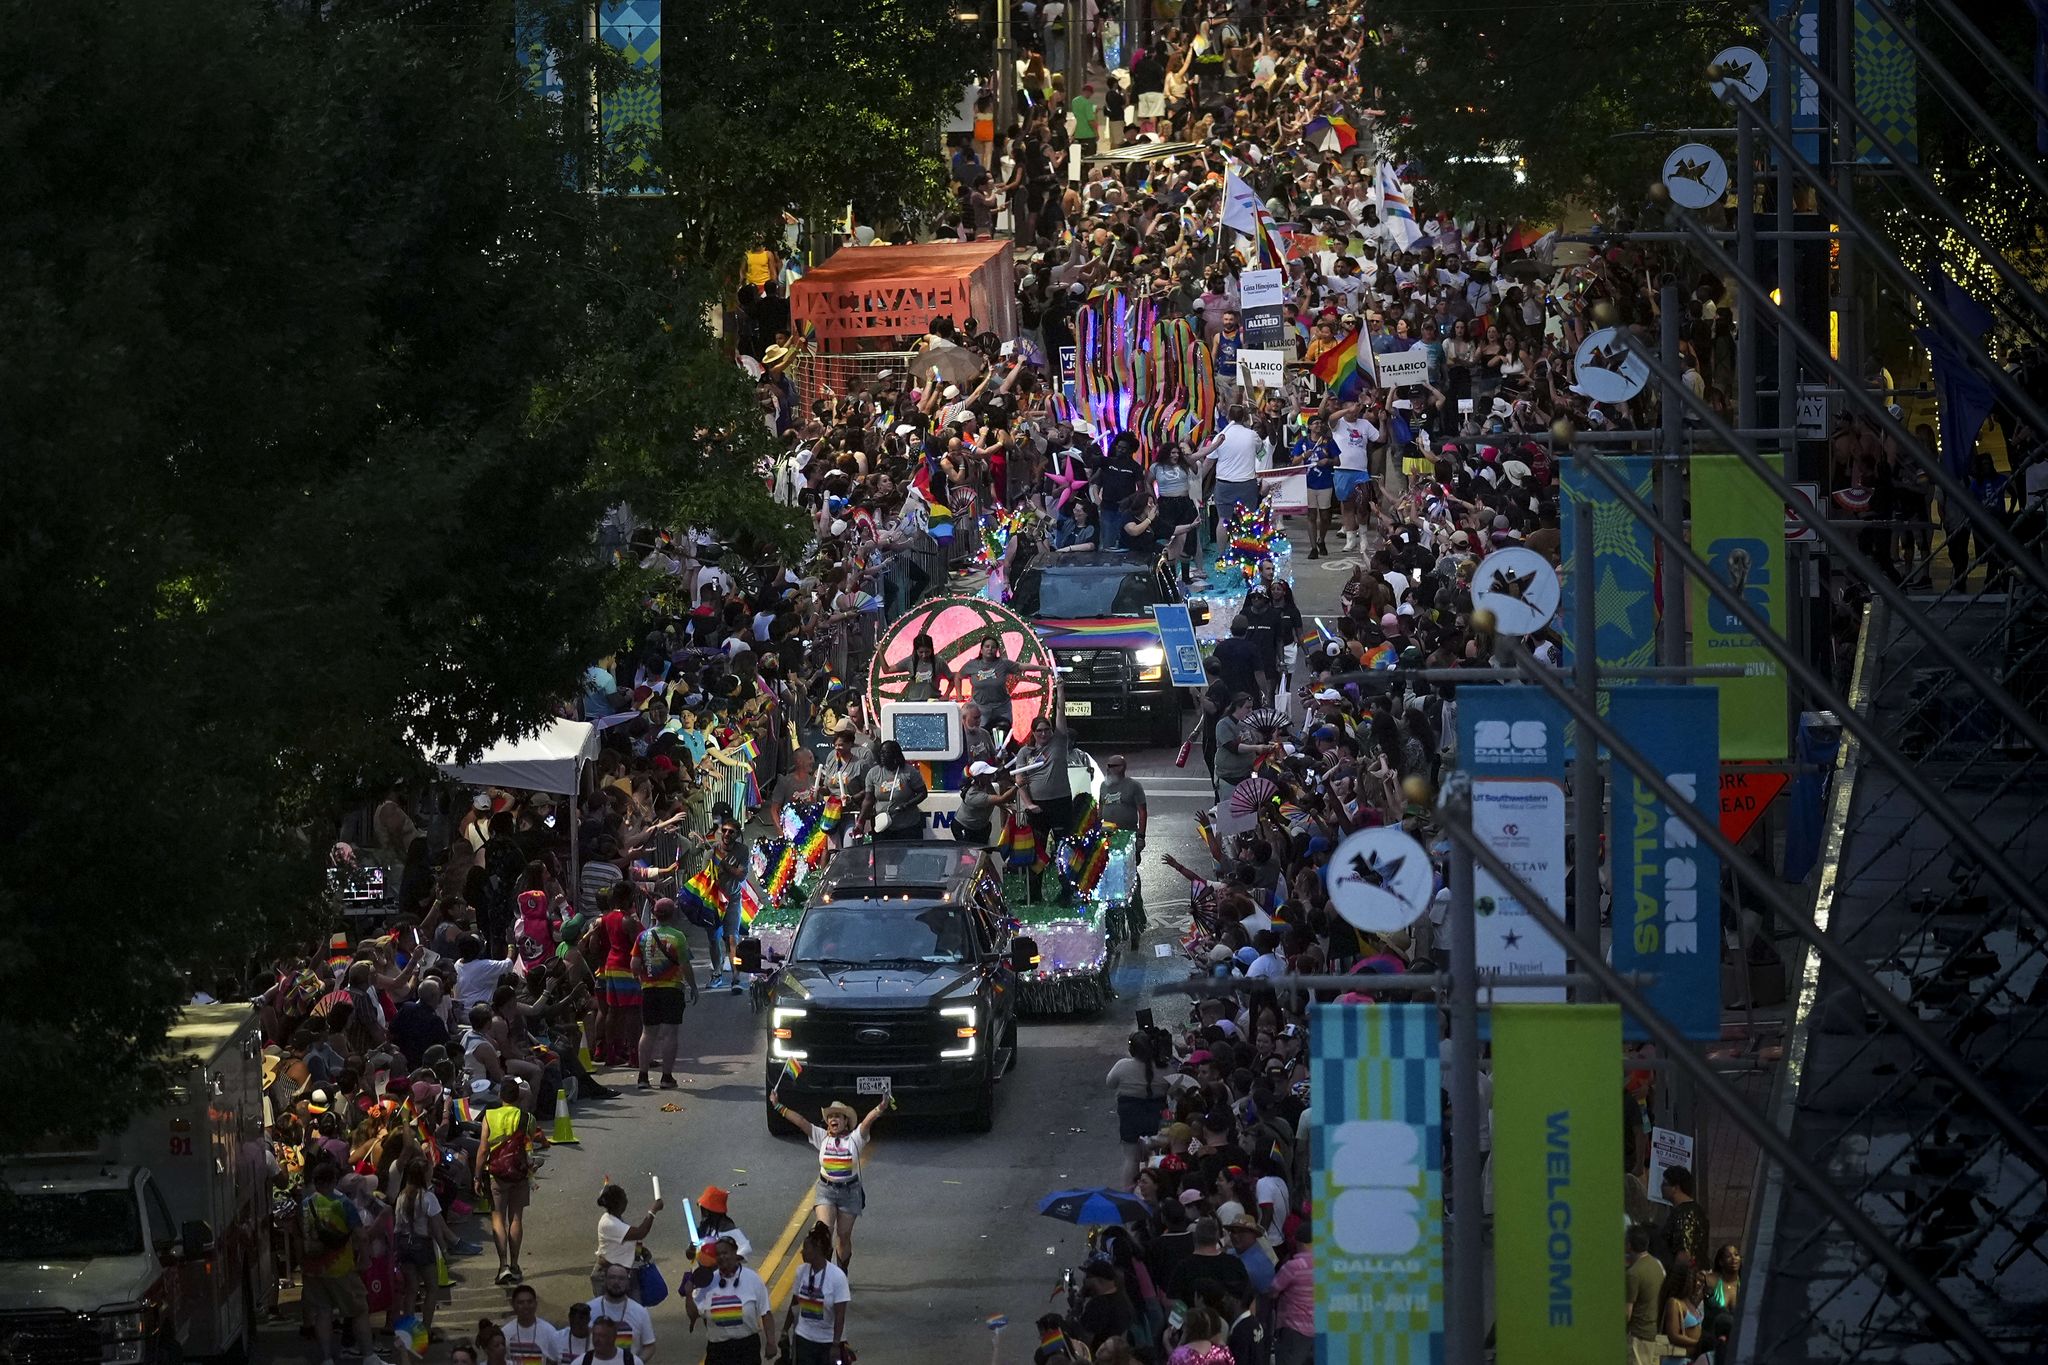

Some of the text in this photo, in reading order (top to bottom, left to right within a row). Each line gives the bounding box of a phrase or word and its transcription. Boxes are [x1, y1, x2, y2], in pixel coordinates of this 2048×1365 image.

[811, 285, 952, 314] ACTIVATE
[1248, 318, 1279, 328] ALLRED
[1265, 338, 1296, 348] TALARICO
[1238, 361, 1282, 371] LARICO
[1381, 361, 1427, 373] TALARICO
[1797, 404, 1824, 417] AY
[1708, 639, 1765, 648] DALLA
[1474, 748, 1547, 756] DALLAS
[1719, 774, 1748, 789] RK
[1485, 794, 1548, 802] Southwestern
[1721, 795, 1756, 813] EAD
[1632, 774, 1659, 955] DALLAS
[169, 1136, 193, 1156] 91
[1545, 1109, 1573, 1328] WELCOME
